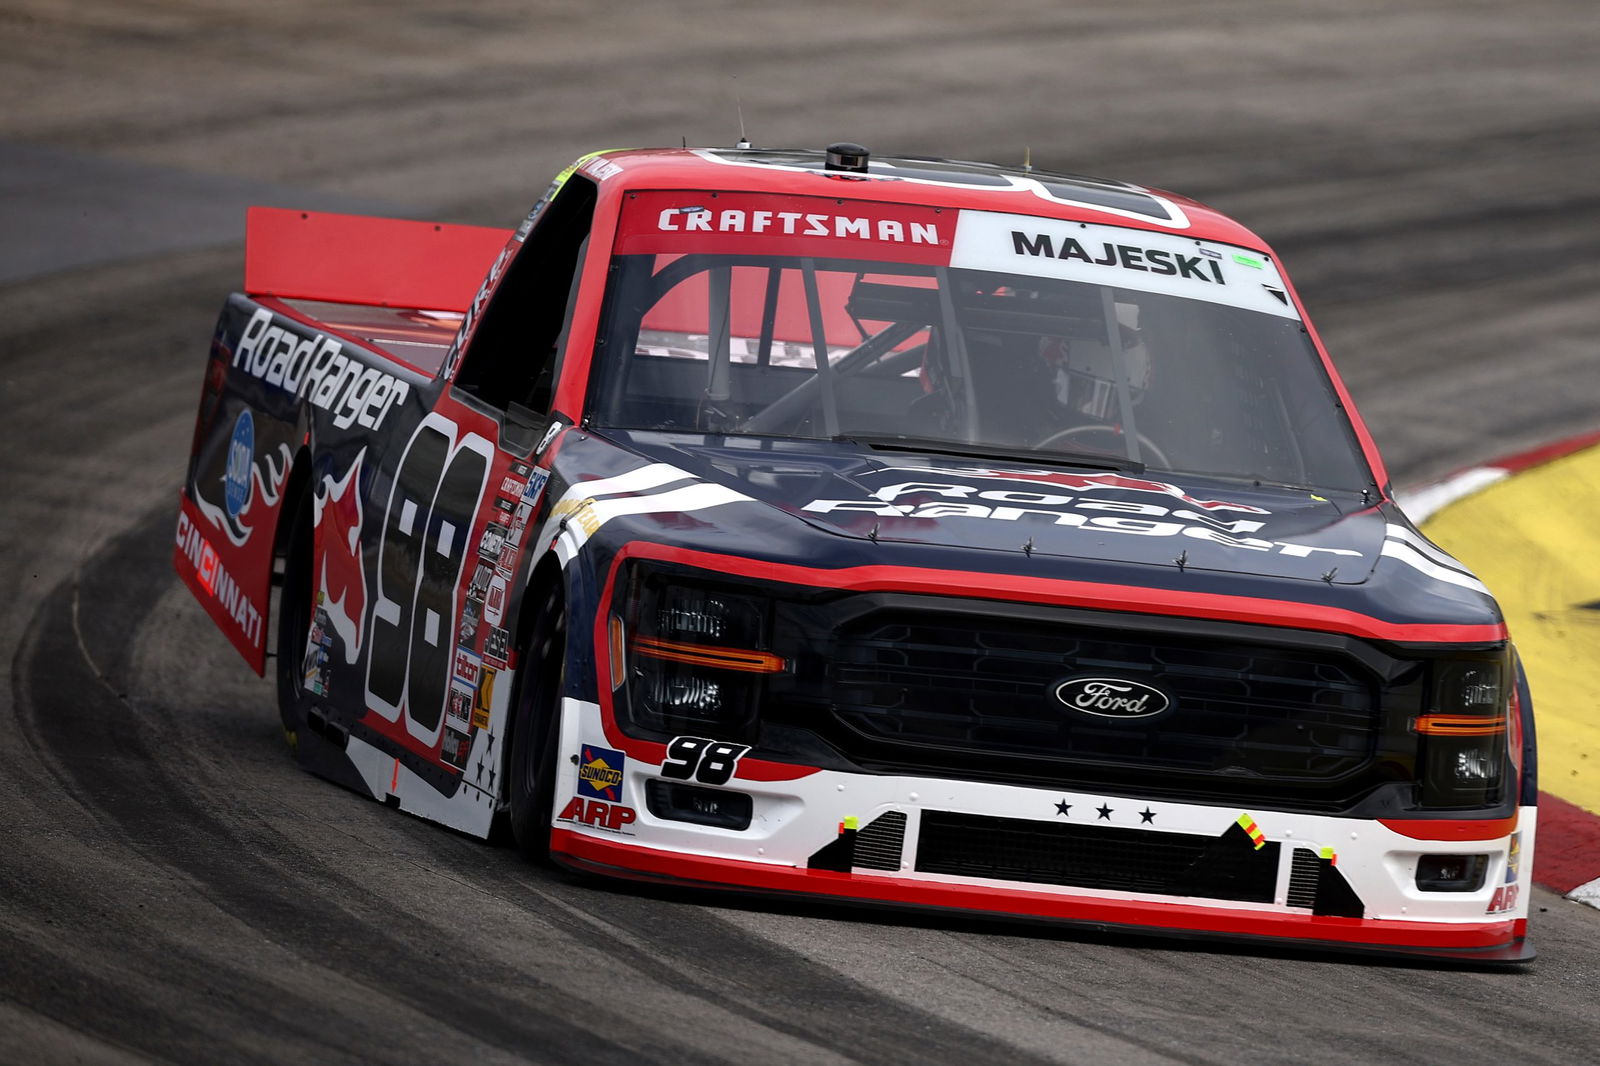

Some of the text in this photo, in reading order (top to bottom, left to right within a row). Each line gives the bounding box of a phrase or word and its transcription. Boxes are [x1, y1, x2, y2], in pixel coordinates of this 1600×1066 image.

[657, 208, 938, 245] CRAFTSMAN
[1011, 231, 1226, 286] MAJESKI
[523, 471, 548, 500] SKF
[176, 511, 262, 648] CINCINNATI
[365, 411, 495, 749] 98
[1075, 682, 1150, 713] Ford
[581, 765, 620, 785] SUNOCO
[660, 736, 752, 786] 98
[558, 796, 637, 830] ARP
